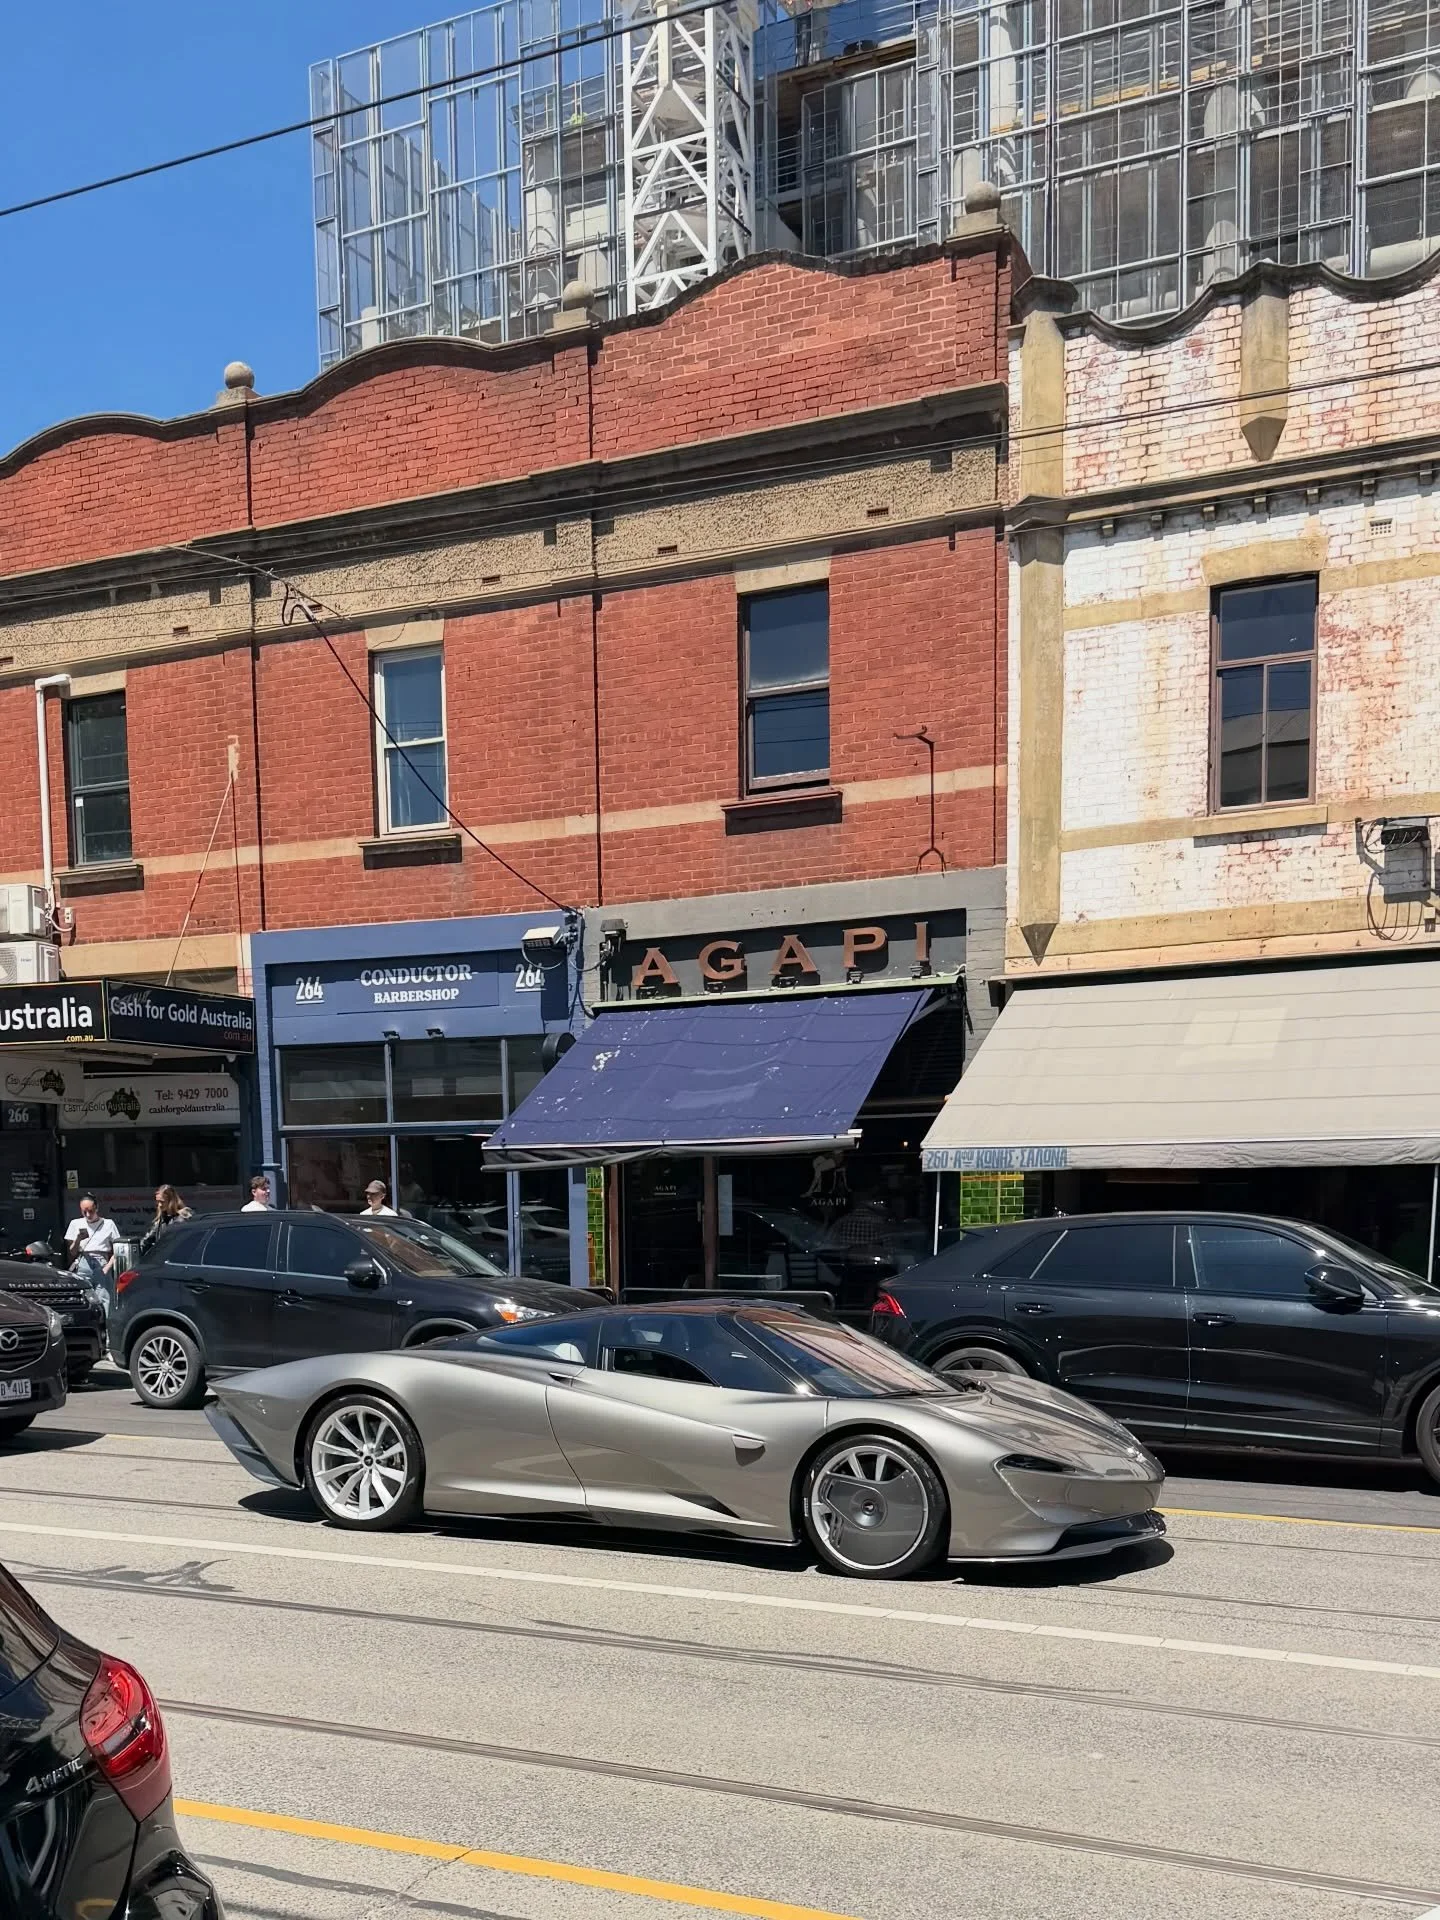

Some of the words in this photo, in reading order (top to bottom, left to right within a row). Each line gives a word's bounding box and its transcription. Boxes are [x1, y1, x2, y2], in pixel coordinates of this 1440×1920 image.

[632, 921, 930, 988] AGAPI
[360, 964, 473, 986] CONDUCTOR
[515, 963, 546, 988] 264
[295, 976, 324, 1000] 264
[374, 988, 459, 1004] BARBERSHOP
[110, 996, 142, 1018] Cash
[145, 1000, 165, 1021] for
[168, 1003, 198, 1024] Gold
[200, 1007, 252, 1030] Australia
[155, 1089, 174, 1100] Tel:
[177, 1088, 200, 1099] 9429
[204, 1087, 229, 1098] 7000
[8, 1108, 29, 1122] 266
[927, 1151, 948, 1169] 260
